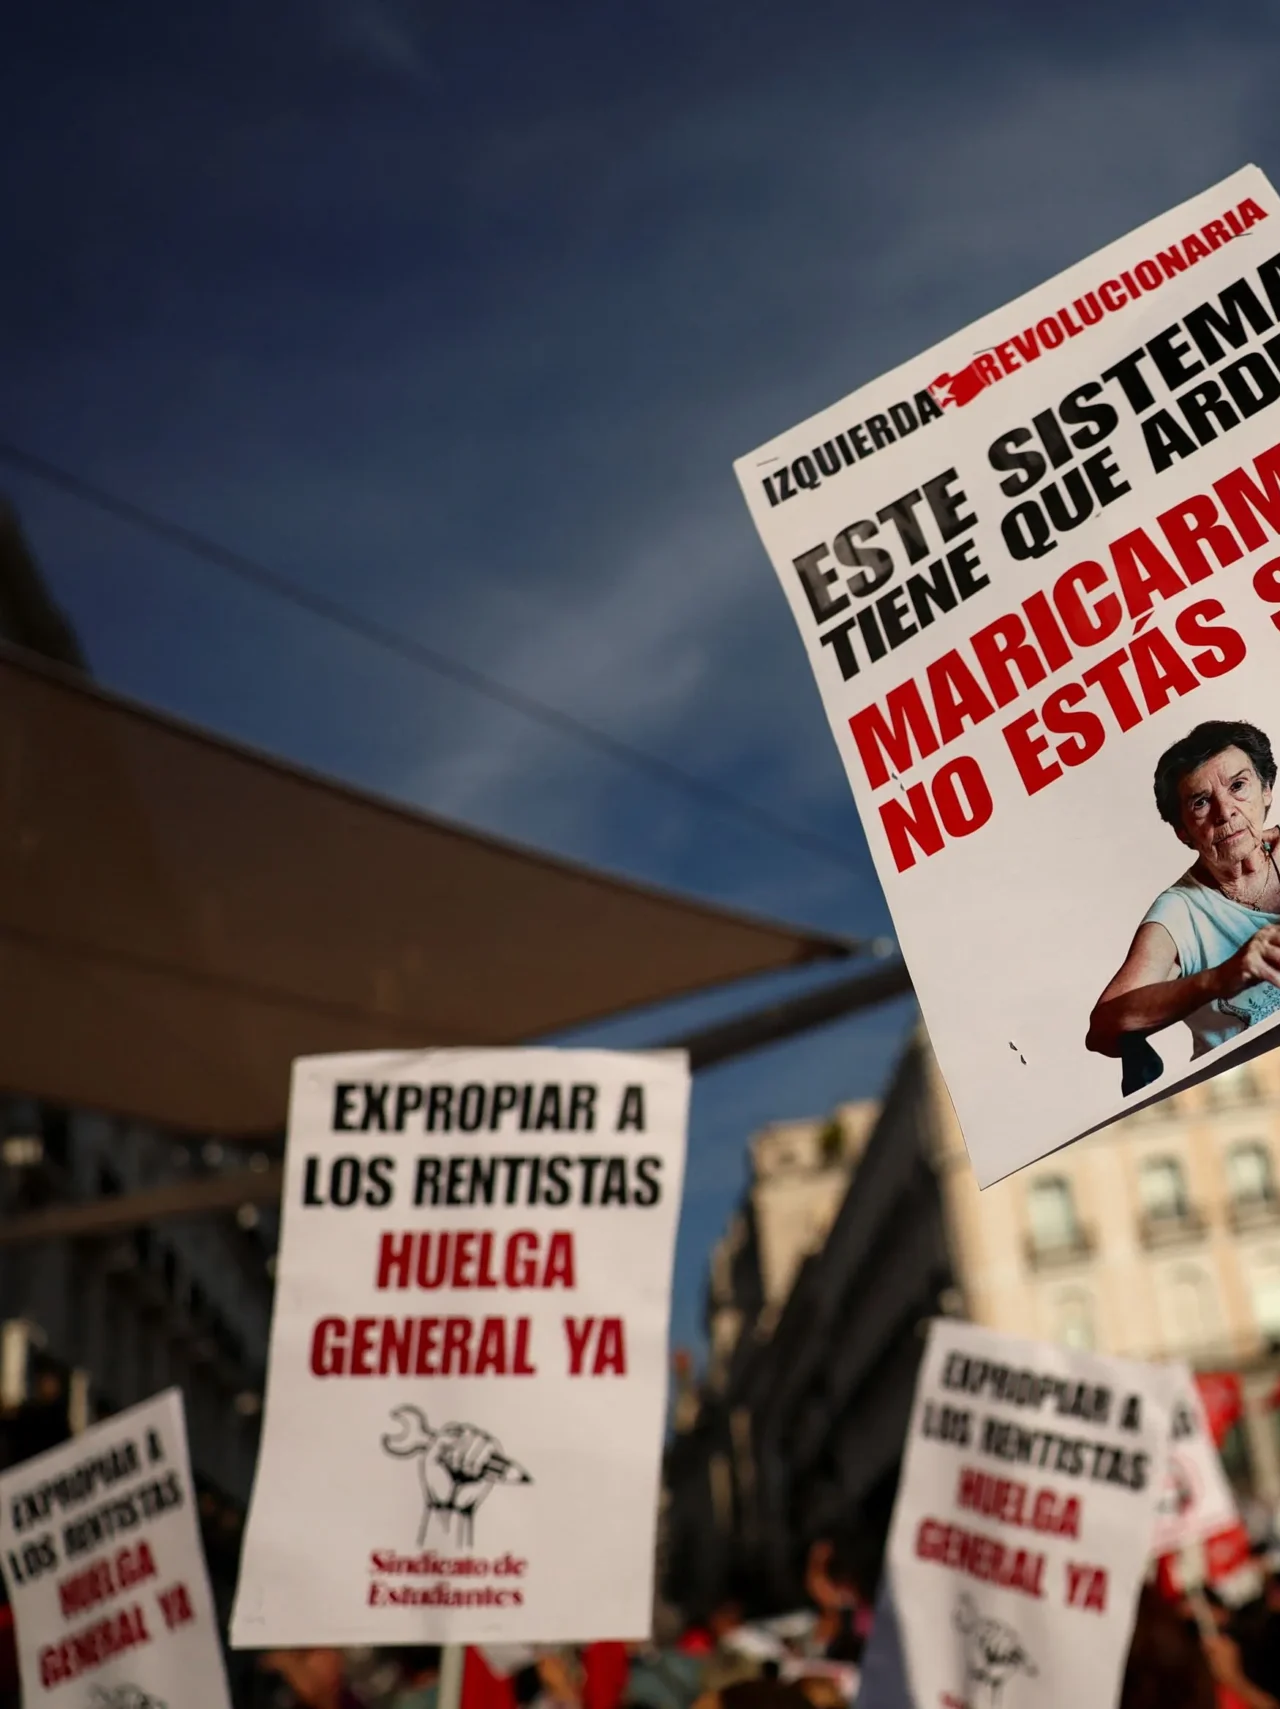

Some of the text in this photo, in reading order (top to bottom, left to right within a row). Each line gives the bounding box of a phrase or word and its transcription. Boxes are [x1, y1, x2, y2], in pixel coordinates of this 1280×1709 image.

[761, 197, 1269, 507] IZQUIERDA REVOLUCIONARIA
[792, 467, 978, 625] ESTE
[819, 546, 991, 682] TIENE
[1000, 447, 1131, 561] QUE
[878, 755, 993, 874] NO
[1001, 598, 1247, 796] ESTÁS
[331, 1082, 647, 1133] EXPROPIAR A
[302, 1156, 663, 1209] LOS RENTISTAS
[377, 1230, 577, 1290] HUELGA
[309, 1317, 628, 1379] GENERAL YA
[943, 1350, 1111, 1430] EXPROPIAR
[1119, 1394, 1142, 1435] A
[922, 1399, 973, 1447] LOS
[980, 1415, 1149, 1492] RENTISTAS
[956, 1465, 1082, 1540] HUELGA
[8, 1534, 57, 1584] LOS
[59, 1540, 156, 1619] HUELGA
[368, 1582, 524, 1607] Estudiantes
[370, 1550, 527, 1577] Sindicato de
[915, 1518, 1109, 1615] GENERAL YA
[39, 1582, 194, 1691] GENERAL YA
